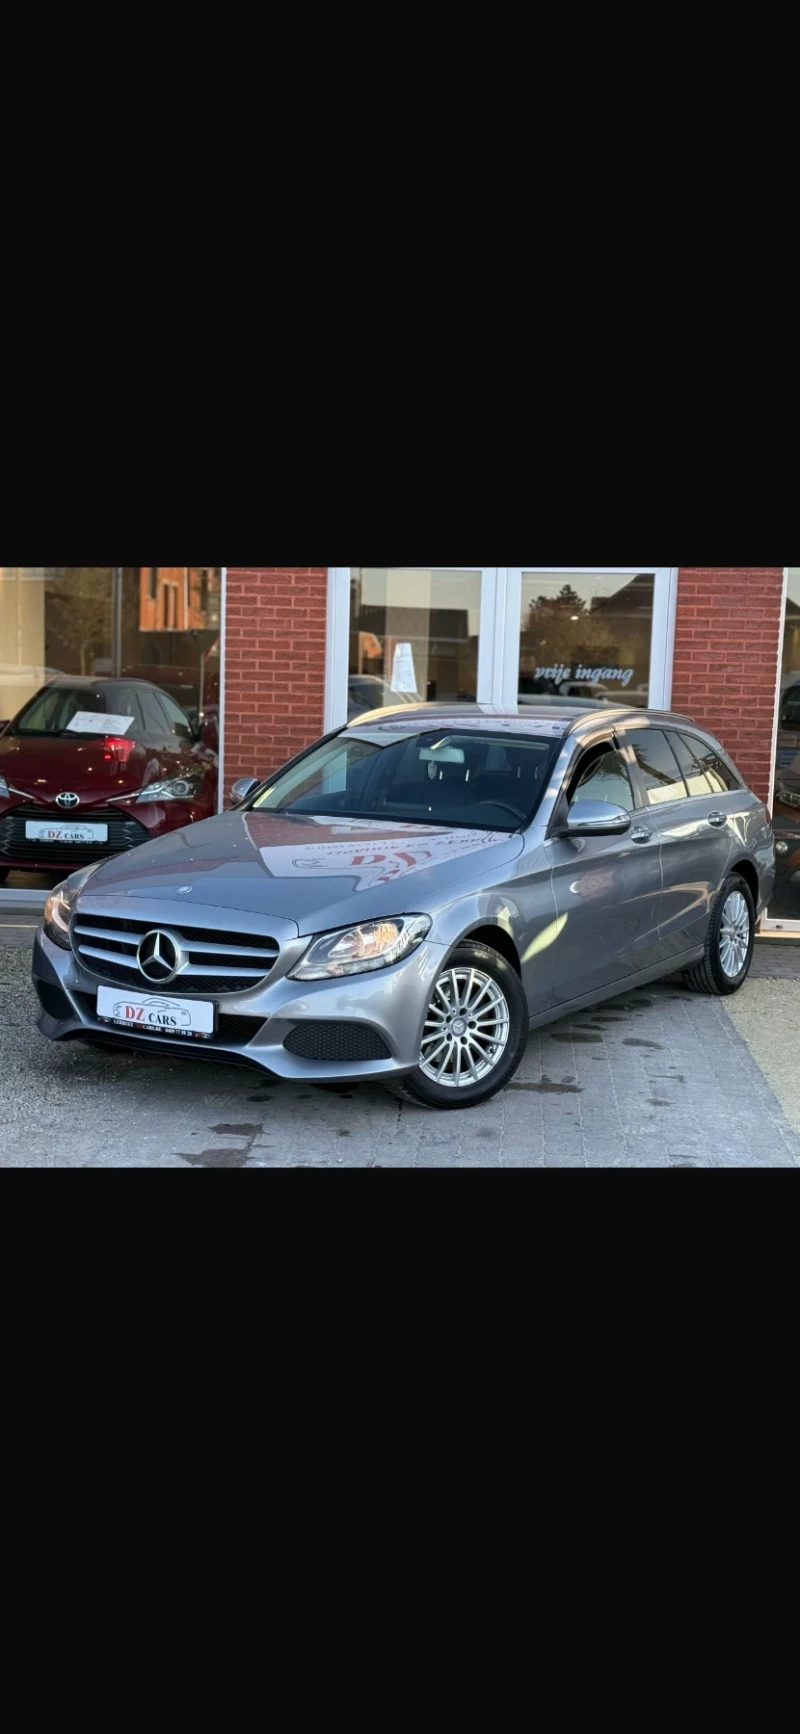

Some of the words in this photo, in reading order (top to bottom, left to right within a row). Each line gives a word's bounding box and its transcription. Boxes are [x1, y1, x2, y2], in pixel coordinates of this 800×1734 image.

[534, 663, 572, 685] vrije
[575, 664, 634, 688] ingang
[48, 830, 62, 839] DZ
[64, 832, 84, 840] CARS
[124, 1005, 145, 1021] DZ
[148, 1012, 177, 1027] CARS
